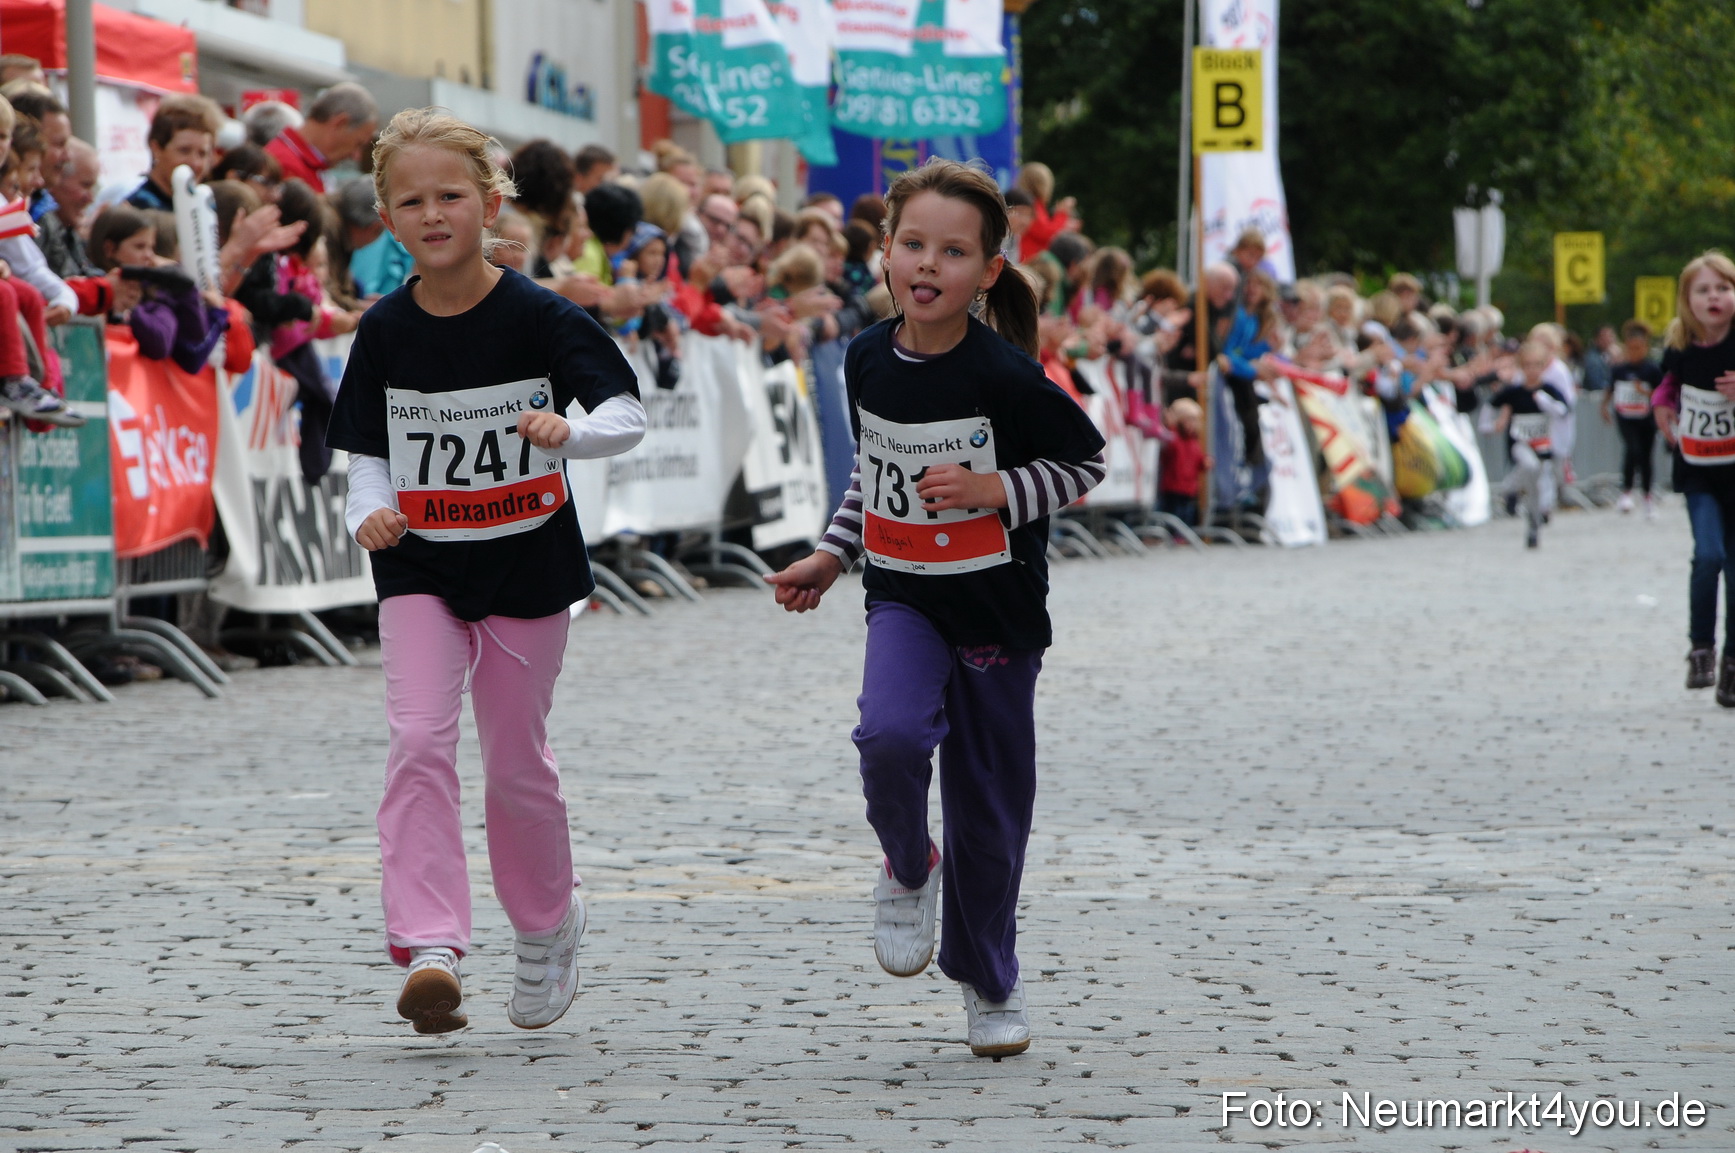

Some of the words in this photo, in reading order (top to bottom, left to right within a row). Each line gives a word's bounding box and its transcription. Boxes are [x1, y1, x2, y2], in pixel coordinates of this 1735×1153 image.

[912, 95, 982, 127] 6352
[1214, 82, 1246, 129] B
[1567, 253, 1590, 286] C
[440, 399, 523, 423] Neumarkt
[1687, 406, 1735, 437] 725
[860, 425, 886, 449] PARTL
[887, 437, 963, 454] Neumarkt
[406, 424, 532, 487] 7247
[546, 460, 558, 471] W
[424, 492, 541, 523] Alexandra
